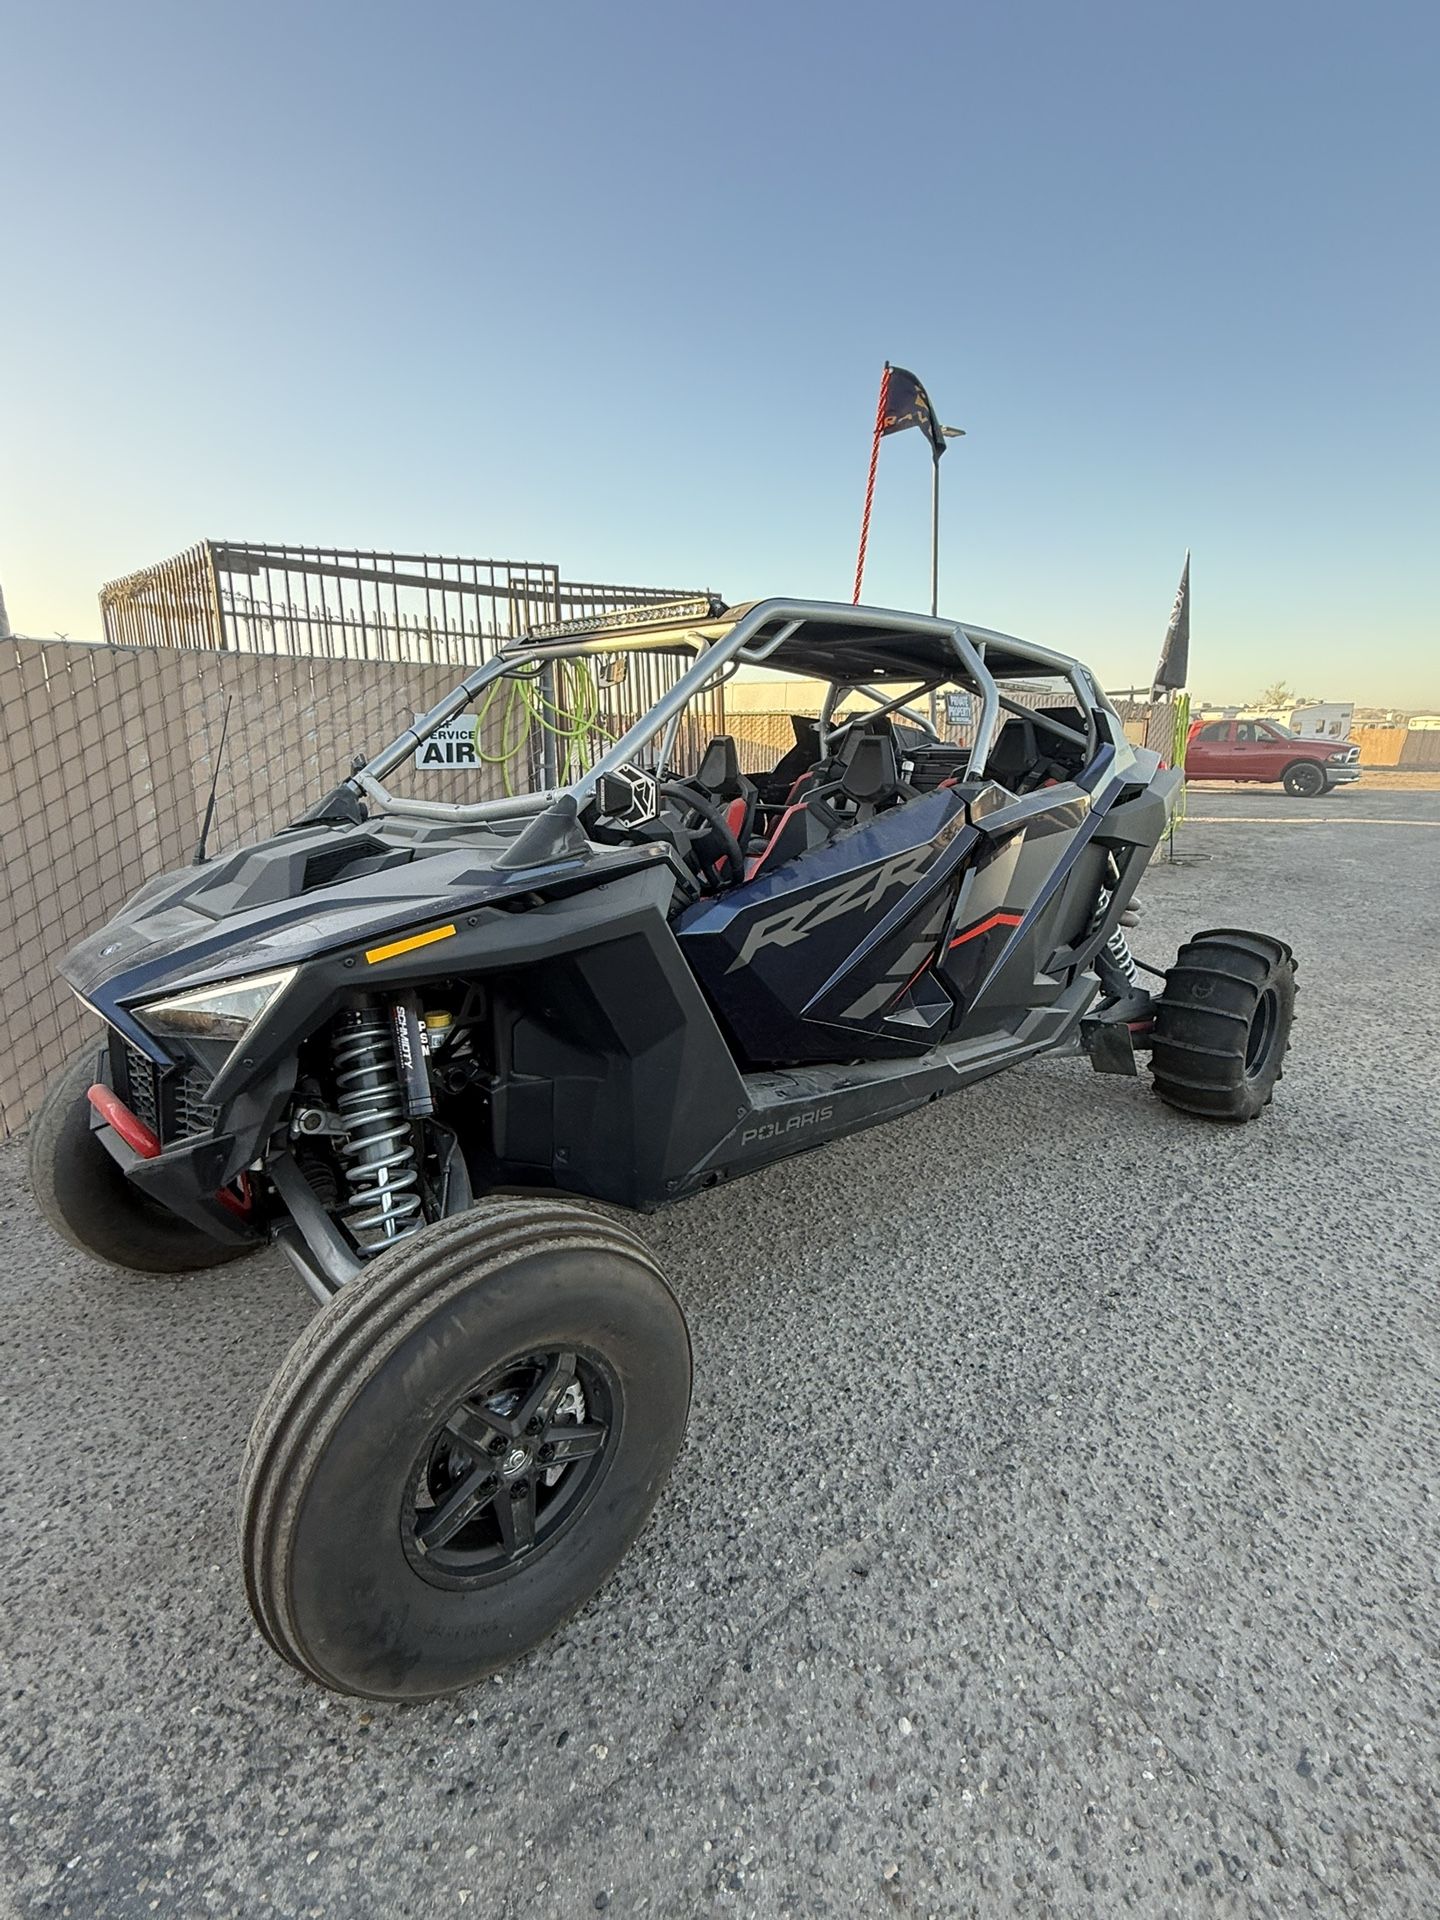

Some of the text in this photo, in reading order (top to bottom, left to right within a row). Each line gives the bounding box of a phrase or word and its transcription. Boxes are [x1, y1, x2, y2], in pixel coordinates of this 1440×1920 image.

[423, 742, 475, 763] AIR
[430, 731, 475, 739] ERVICE
[724, 845, 930, 975] RZR
[396, 1006, 413, 1070] SCHMIDTY
[741, 1105, 833, 1146] POLARIS
